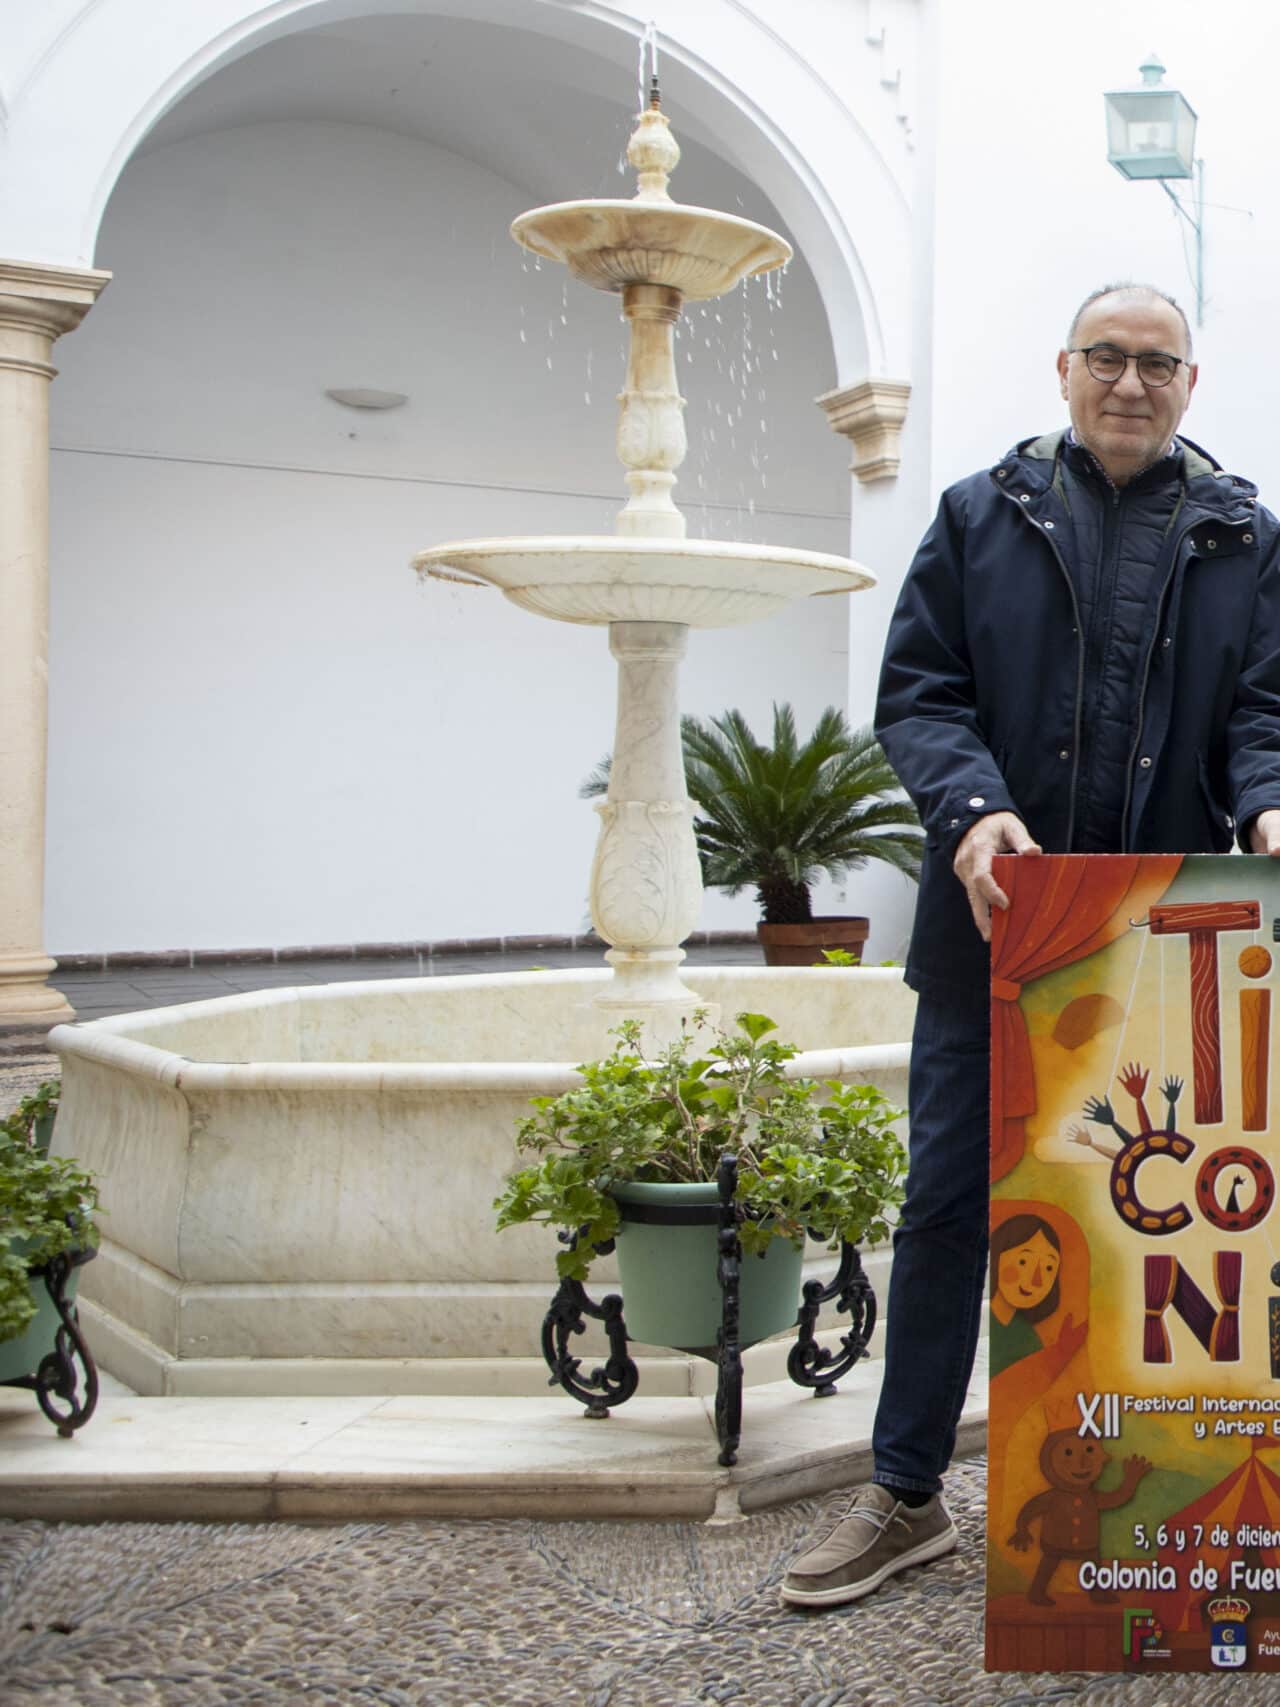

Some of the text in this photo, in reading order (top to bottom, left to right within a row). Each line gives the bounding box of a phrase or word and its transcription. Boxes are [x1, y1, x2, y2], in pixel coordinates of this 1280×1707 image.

[1076, 1392, 1119, 1438] XII
[1123, 1395, 1195, 1412] Festival
[1194, 1421, 1206, 1438] y
[1214, 1419, 1265, 1435] Artes
[1134, 1524, 1150, 1549] 5,
[1157, 1524, 1168, 1546] 6
[1175, 1529, 1186, 1551] y
[1193, 1524, 1203, 1546] 7
[1211, 1524, 1229, 1546] de
[1079, 1560, 1176, 1590] Colonia
[1189, 1560, 1218, 1590] de
